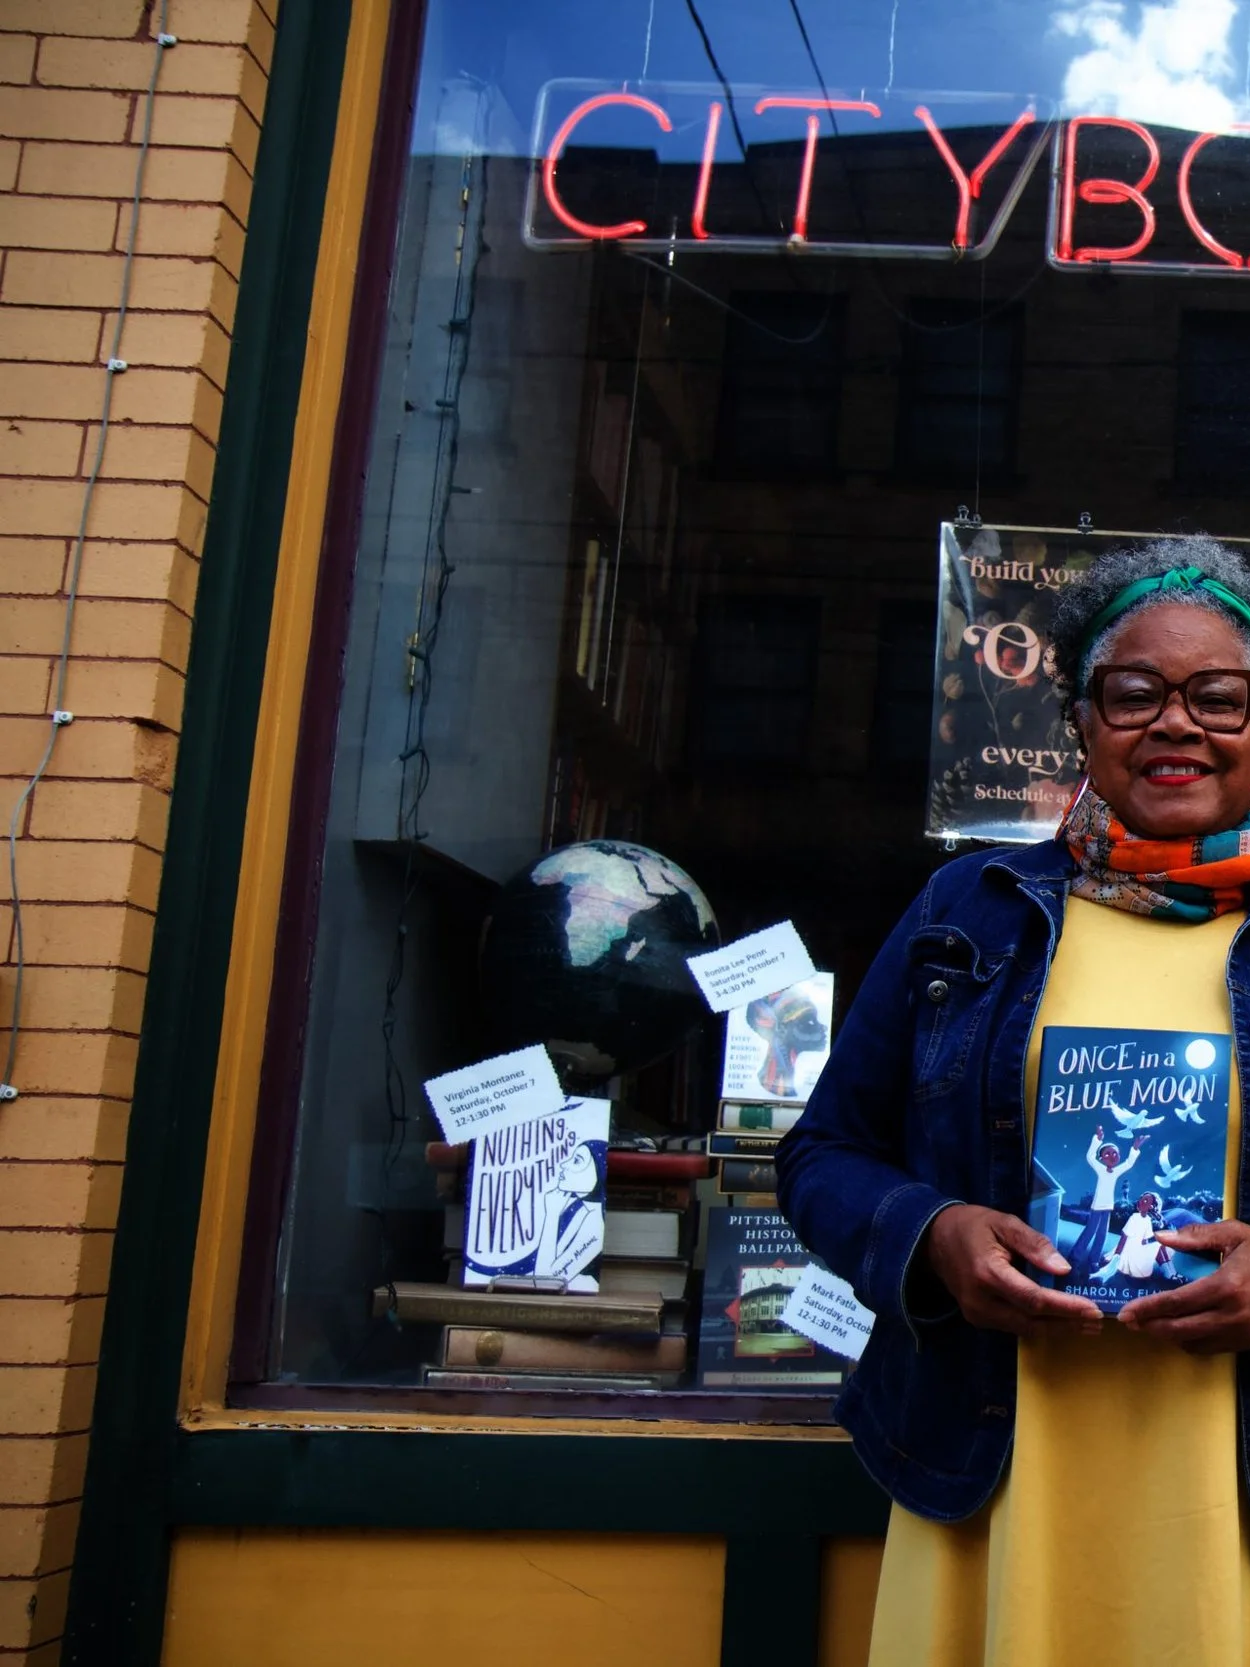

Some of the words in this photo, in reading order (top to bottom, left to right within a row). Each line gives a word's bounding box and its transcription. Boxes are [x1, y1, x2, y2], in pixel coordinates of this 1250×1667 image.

[540, 92, 1037, 245] CITY
[1034, 568, 1084, 590] you
[981, 746, 1070, 776] every
[974, 783, 1054, 803] Schedule
[704, 964, 731, 978] Bonita
[730, 958, 746, 968] Lee
[746, 948, 768, 962] Penn
[709, 970, 747, 988] Saturday,
[747, 955, 780, 974] October
[780, 951, 787, 960] 7
[715, 983, 741, 998] 3-4:30
[742, 977, 757, 988] PM
[1058, 1042, 1137, 1075] ONCE
[1139, 1050, 1159, 1069] in
[1163, 1051, 1176, 1067] a
[444, 1085, 480, 1103] Virginia
[480, 1070, 526, 1090] Montanez
[449, 1094, 493, 1115] Saturday,
[493, 1082, 529, 1100] October
[529, 1078, 536, 1087] 7
[1048, 1080, 1122, 1114] BLUE
[1129, 1074, 1218, 1106] MOON
[454, 1107, 490, 1128] 12-1:30
[490, 1103, 507, 1115] PM
[729, 1215, 790, 1226] PITTSBU
[738, 1243, 810, 1254] BALLPAR
[811, 1282, 835, 1299] Mark
[1065, 1285, 1117, 1298] SHARON
[797, 1308, 832, 1331] 12-1:30
[831, 1325, 848, 1340] PM
[803, 1295, 844, 1323] Saturday,
[845, 1315, 872, 1336] Octob
